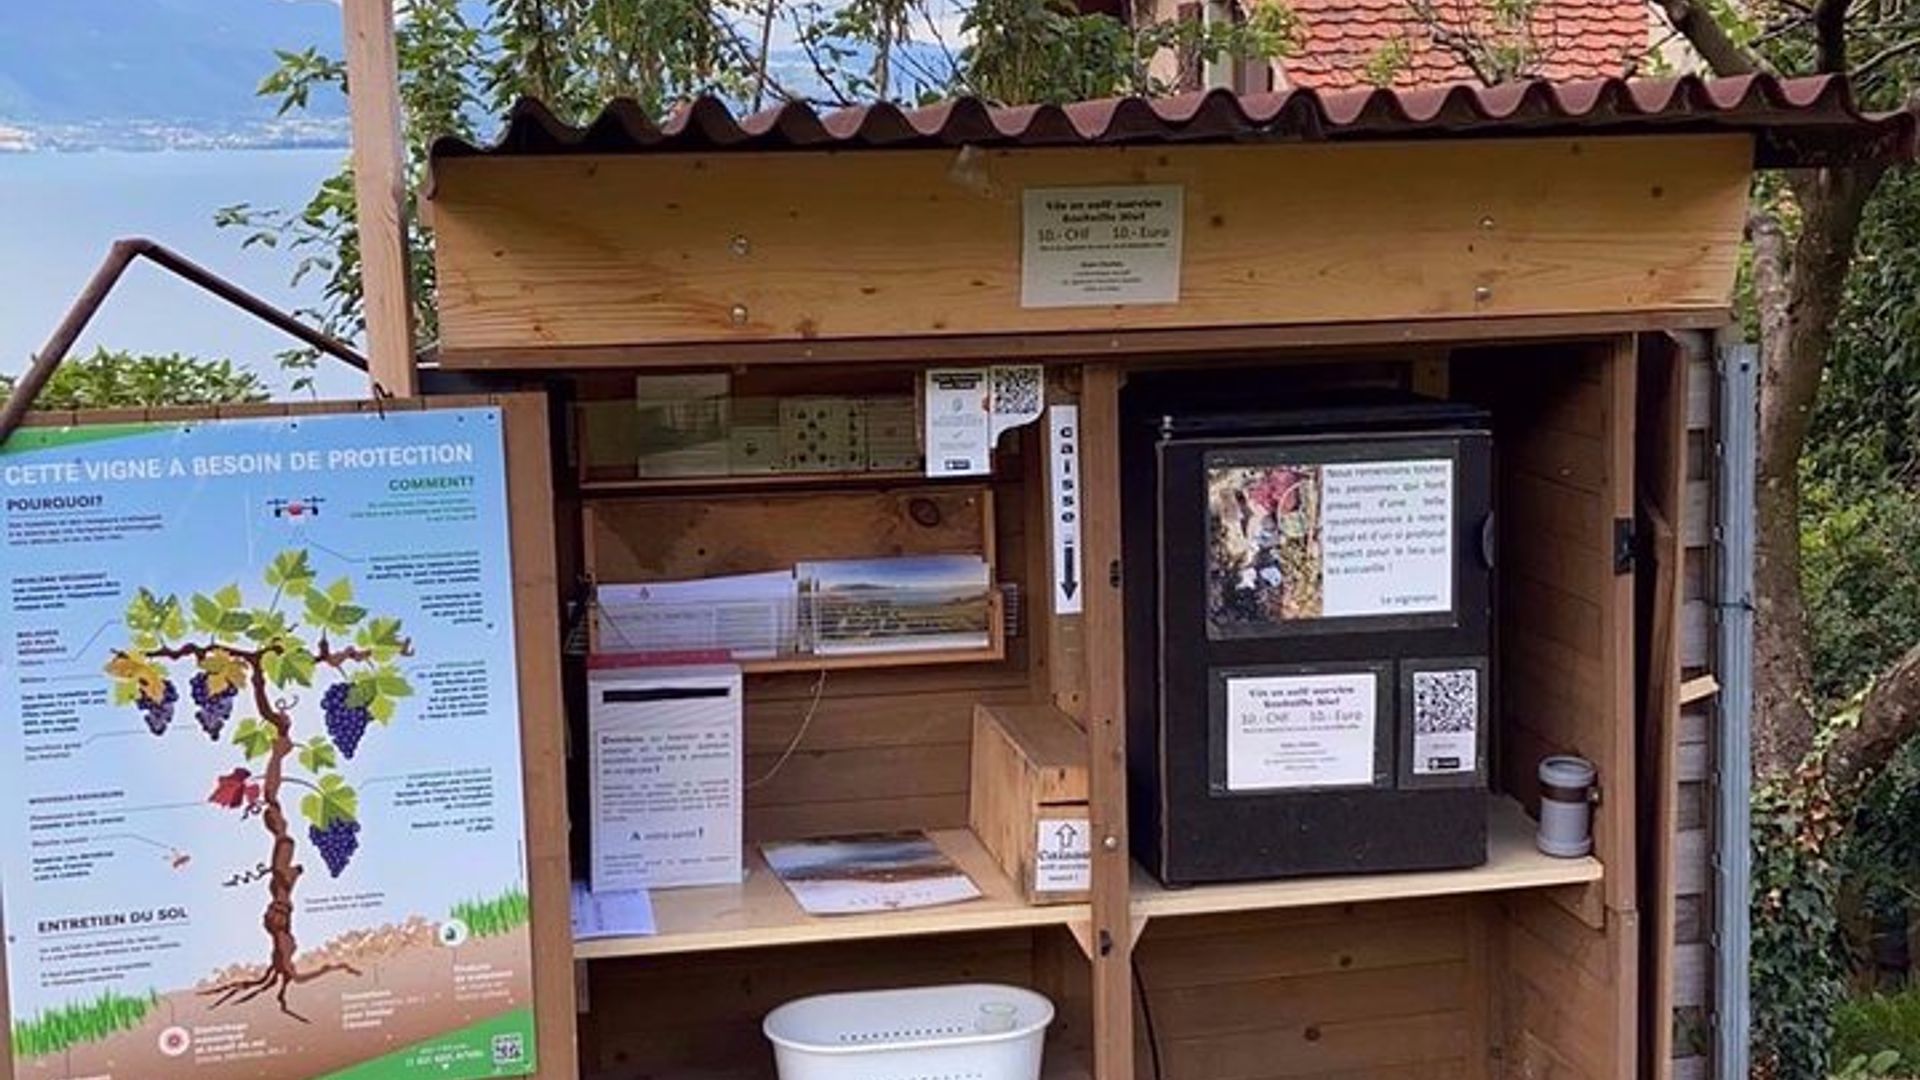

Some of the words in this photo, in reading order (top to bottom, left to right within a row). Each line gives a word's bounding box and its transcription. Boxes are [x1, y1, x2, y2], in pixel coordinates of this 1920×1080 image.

[4, 461, 80, 486] CETTE
[84, 458, 162, 481] VIGNE
[169, 458, 186, 477] A
[193, 452, 281, 476] BESOIN
[290, 451, 322, 471] DE
[328, 443, 473, 470] PROTECTION
[1060, 426, 1075, 523] Caisse
[389, 476, 474, 491] COMMENT?
[6, 495, 103, 511] POURQUOI?
[37, 913, 126, 933] ENTRETIEN
[129, 910, 153, 924] DU
[157, 906, 189, 920] SOL
